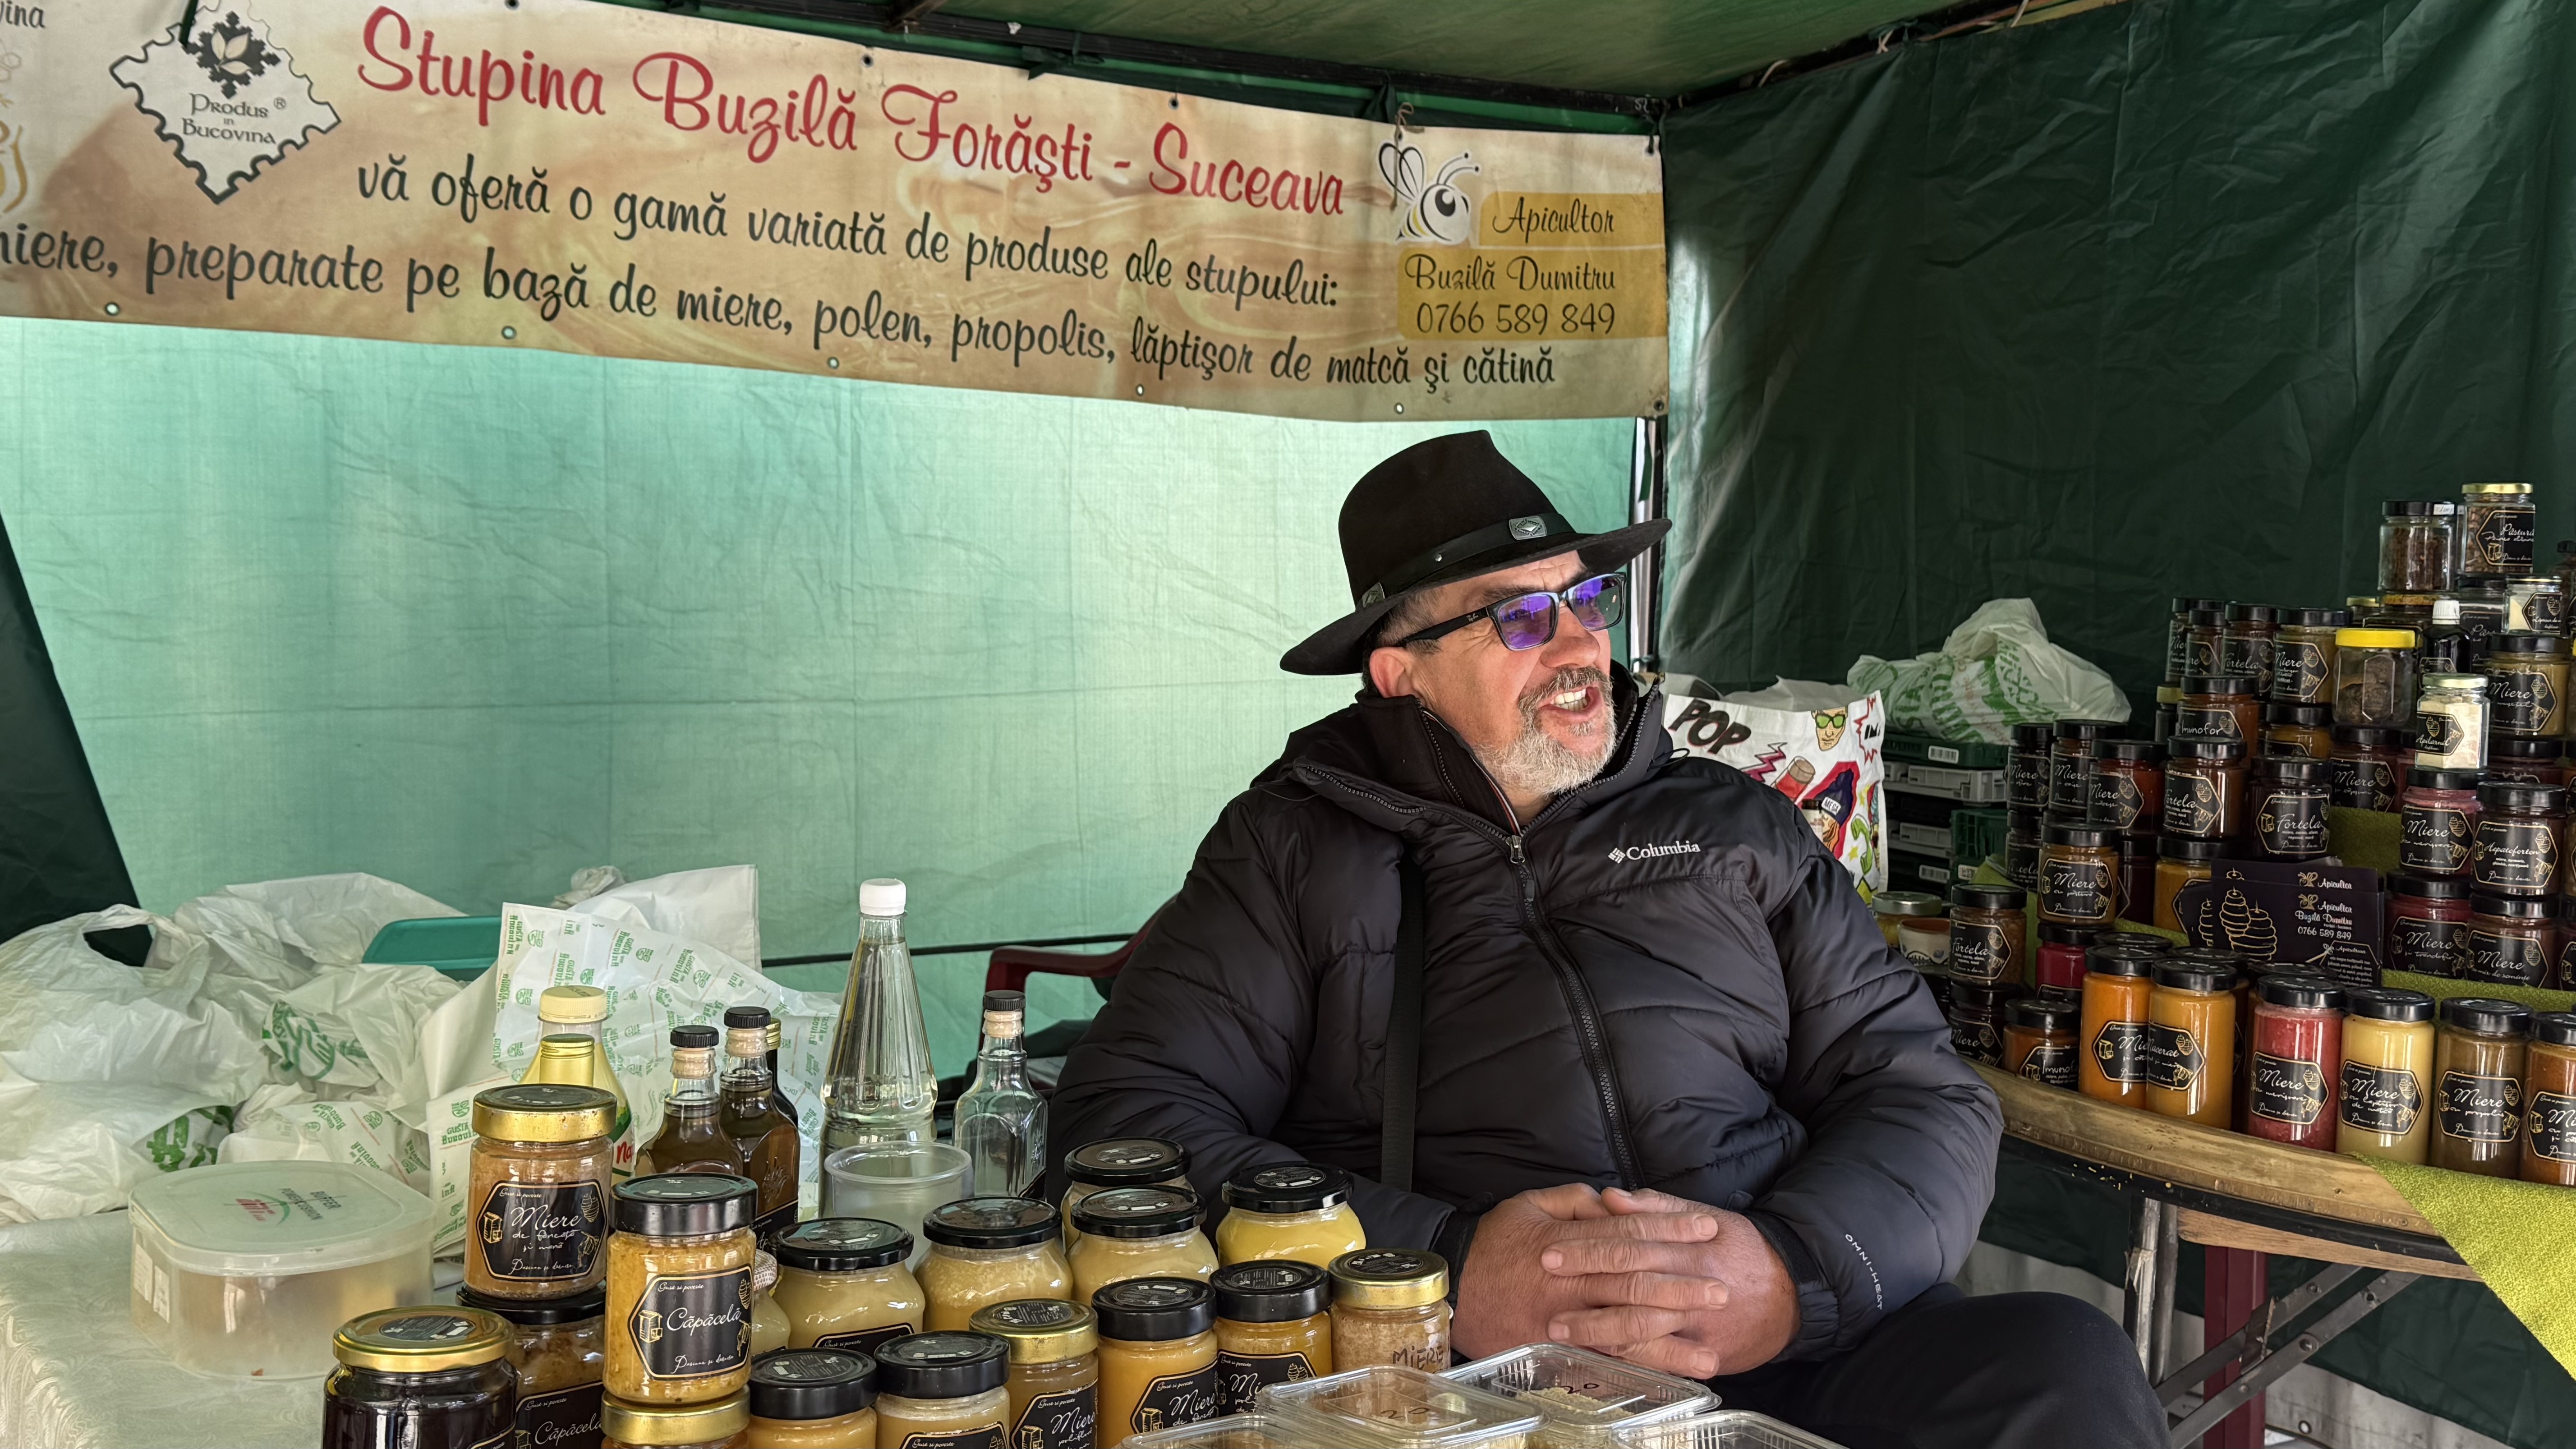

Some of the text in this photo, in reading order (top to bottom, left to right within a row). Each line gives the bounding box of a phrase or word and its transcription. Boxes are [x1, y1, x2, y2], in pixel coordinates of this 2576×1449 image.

[189, 92, 269, 118] Produs
[358, 5, 606, 127] Stupina
[633, 51, 858, 163] Buzilă
[1113, 159, 1132, 170] -
[1148, 122, 1343, 216] Suceava
[1492, 196, 1615, 244] Apicultor
[358, 153, 1338, 311] vă oferă o gamă variată de produse ale stupului:
[1404, 253, 1616, 291] Buzilă Dumitru
[146, 237, 383, 299] preparate
[407, 258, 460, 312] pe
[483, 246, 589, 322] bază
[609, 263, 656, 317] de
[676, 286, 793, 335] miere,
[813, 290, 932, 350] polen,
[952, 309, 1116, 367] propolis,
[1270, 336, 1311, 382] de
[1327, 346, 1411, 383] matcă
[1463, 346, 1555, 383] cătină
[1416, 301, 1615, 336] 0766 589 849
[2489, 681, 2532, 699] Miere
[1669, 698, 1751, 754] POP
[2055, 764, 2088, 781] Miere
[2334, 770, 2376, 787] Miere
[1823, 799, 1839, 814] MEGA
[2277, 814, 2321, 832] Fortela
[2407, 819, 2450, 837] Miere
[1626, 840, 1701, 860] Columbia
[2054, 872, 2097, 888] Miere
[2298, 926, 2351, 940] 0766 589 849
[2406, 932, 2453, 949] Miere
[1952, 937, 1990, 955] Fortela
[2478, 950, 2525, 970] Miere
[2259, 1069, 2304, 1090] Miere
[2352, 1078, 2399, 1099] Miere
[2454, 1088, 2503, 1106] Miere
[511, 1205, 582, 1230] Miere
[512, 1230, 530, 1238] de
[1845, 1234, 1882, 1310] OMNI-HEAT
[1559, 1383, 1600, 1394] 20
[1169, 1389, 1216, 1416] Miere
[1050, 1407, 1095, 1435] Miere
[1173, 1417, 1187, 1426] de
[1380, 1408, 1430, 1419] 20
